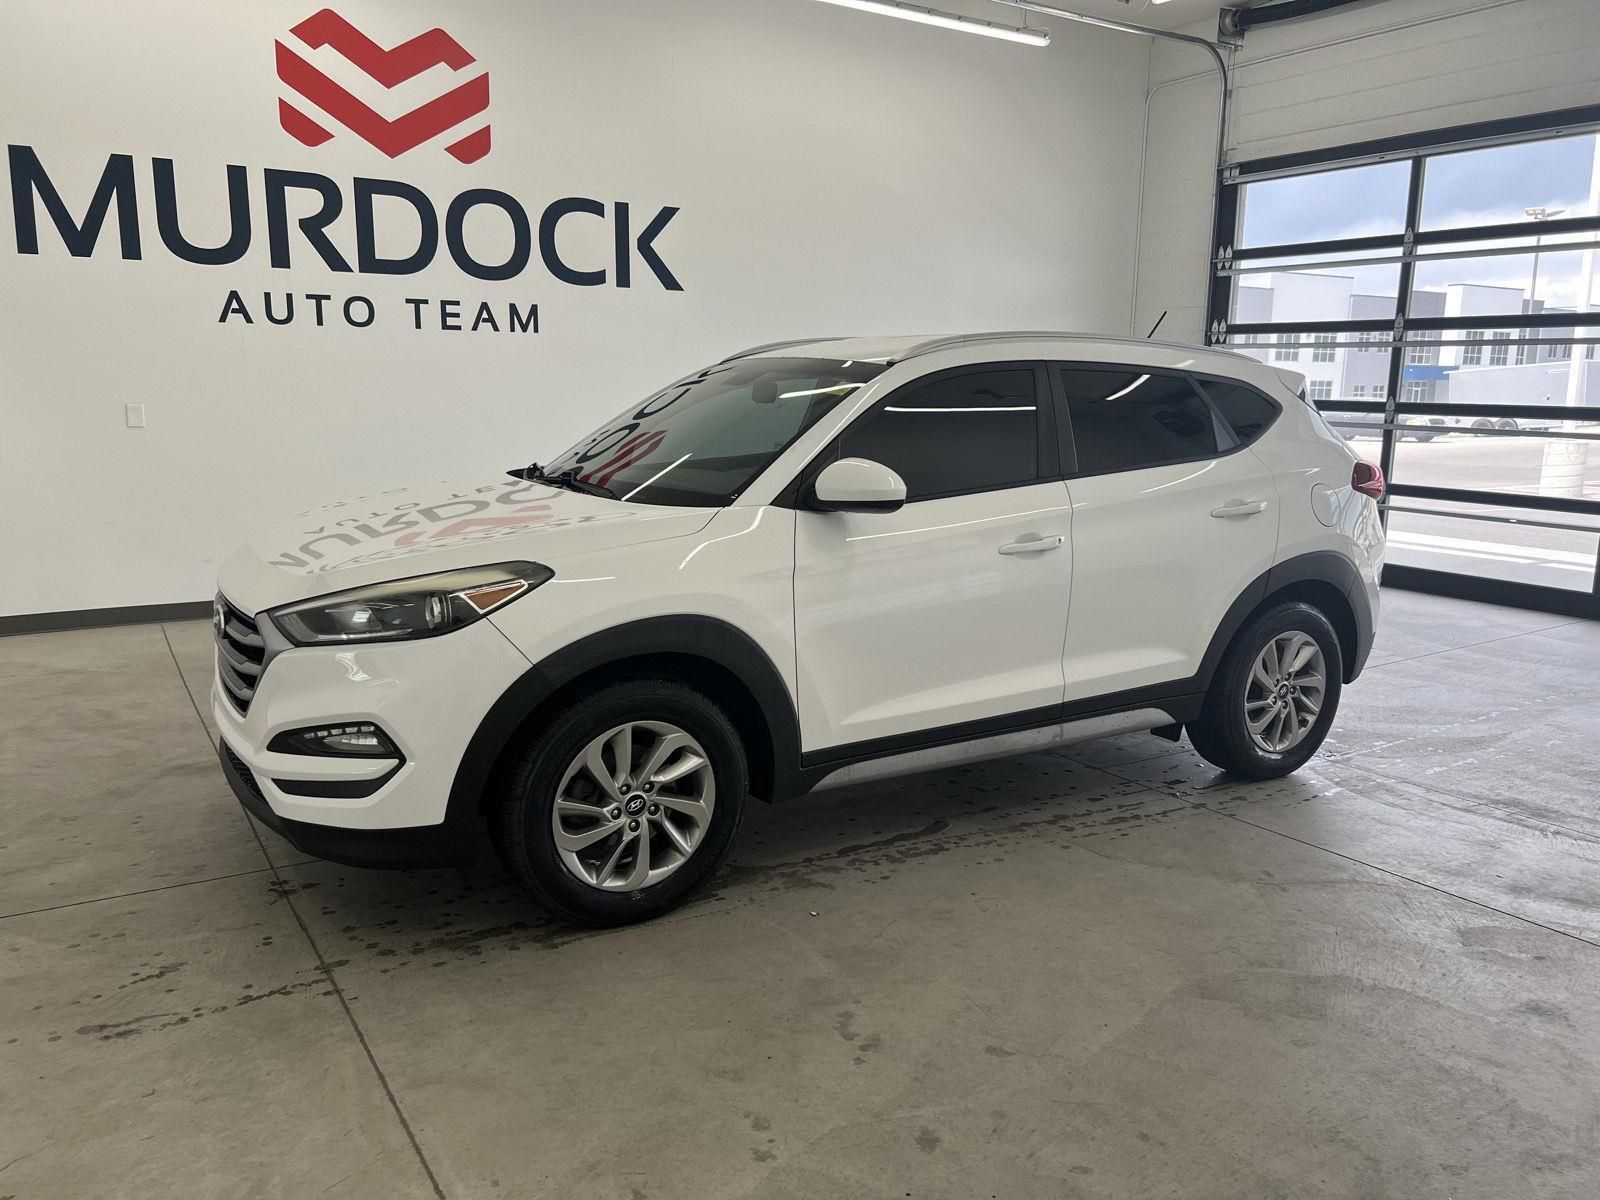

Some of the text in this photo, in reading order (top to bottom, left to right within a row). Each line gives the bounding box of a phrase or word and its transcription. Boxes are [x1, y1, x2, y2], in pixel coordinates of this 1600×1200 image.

[8, 144, 684, 292] MURDOCK
[219, 290, 540, 334] AUTO TEAM
